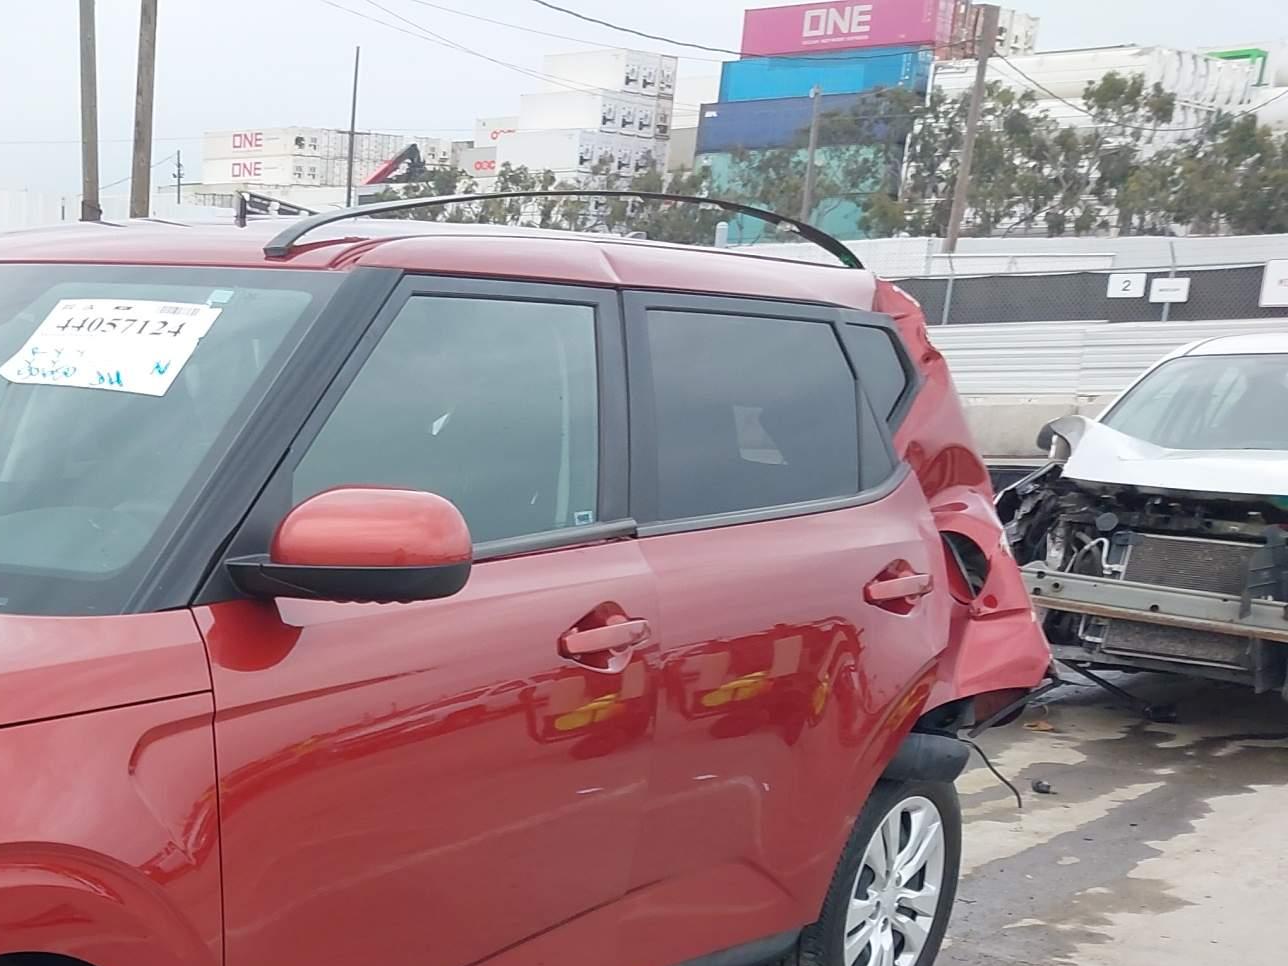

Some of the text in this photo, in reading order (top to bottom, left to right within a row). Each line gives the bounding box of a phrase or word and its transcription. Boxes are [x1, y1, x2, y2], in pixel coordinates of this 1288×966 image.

[802, 5, 872, 37] ONE
[232, 132, 263, 149] ONE
[232, 161, 262, 178] ONE
[1120, 279, 1132, 292] 2
[56, 317, 186, 337] 44057124
